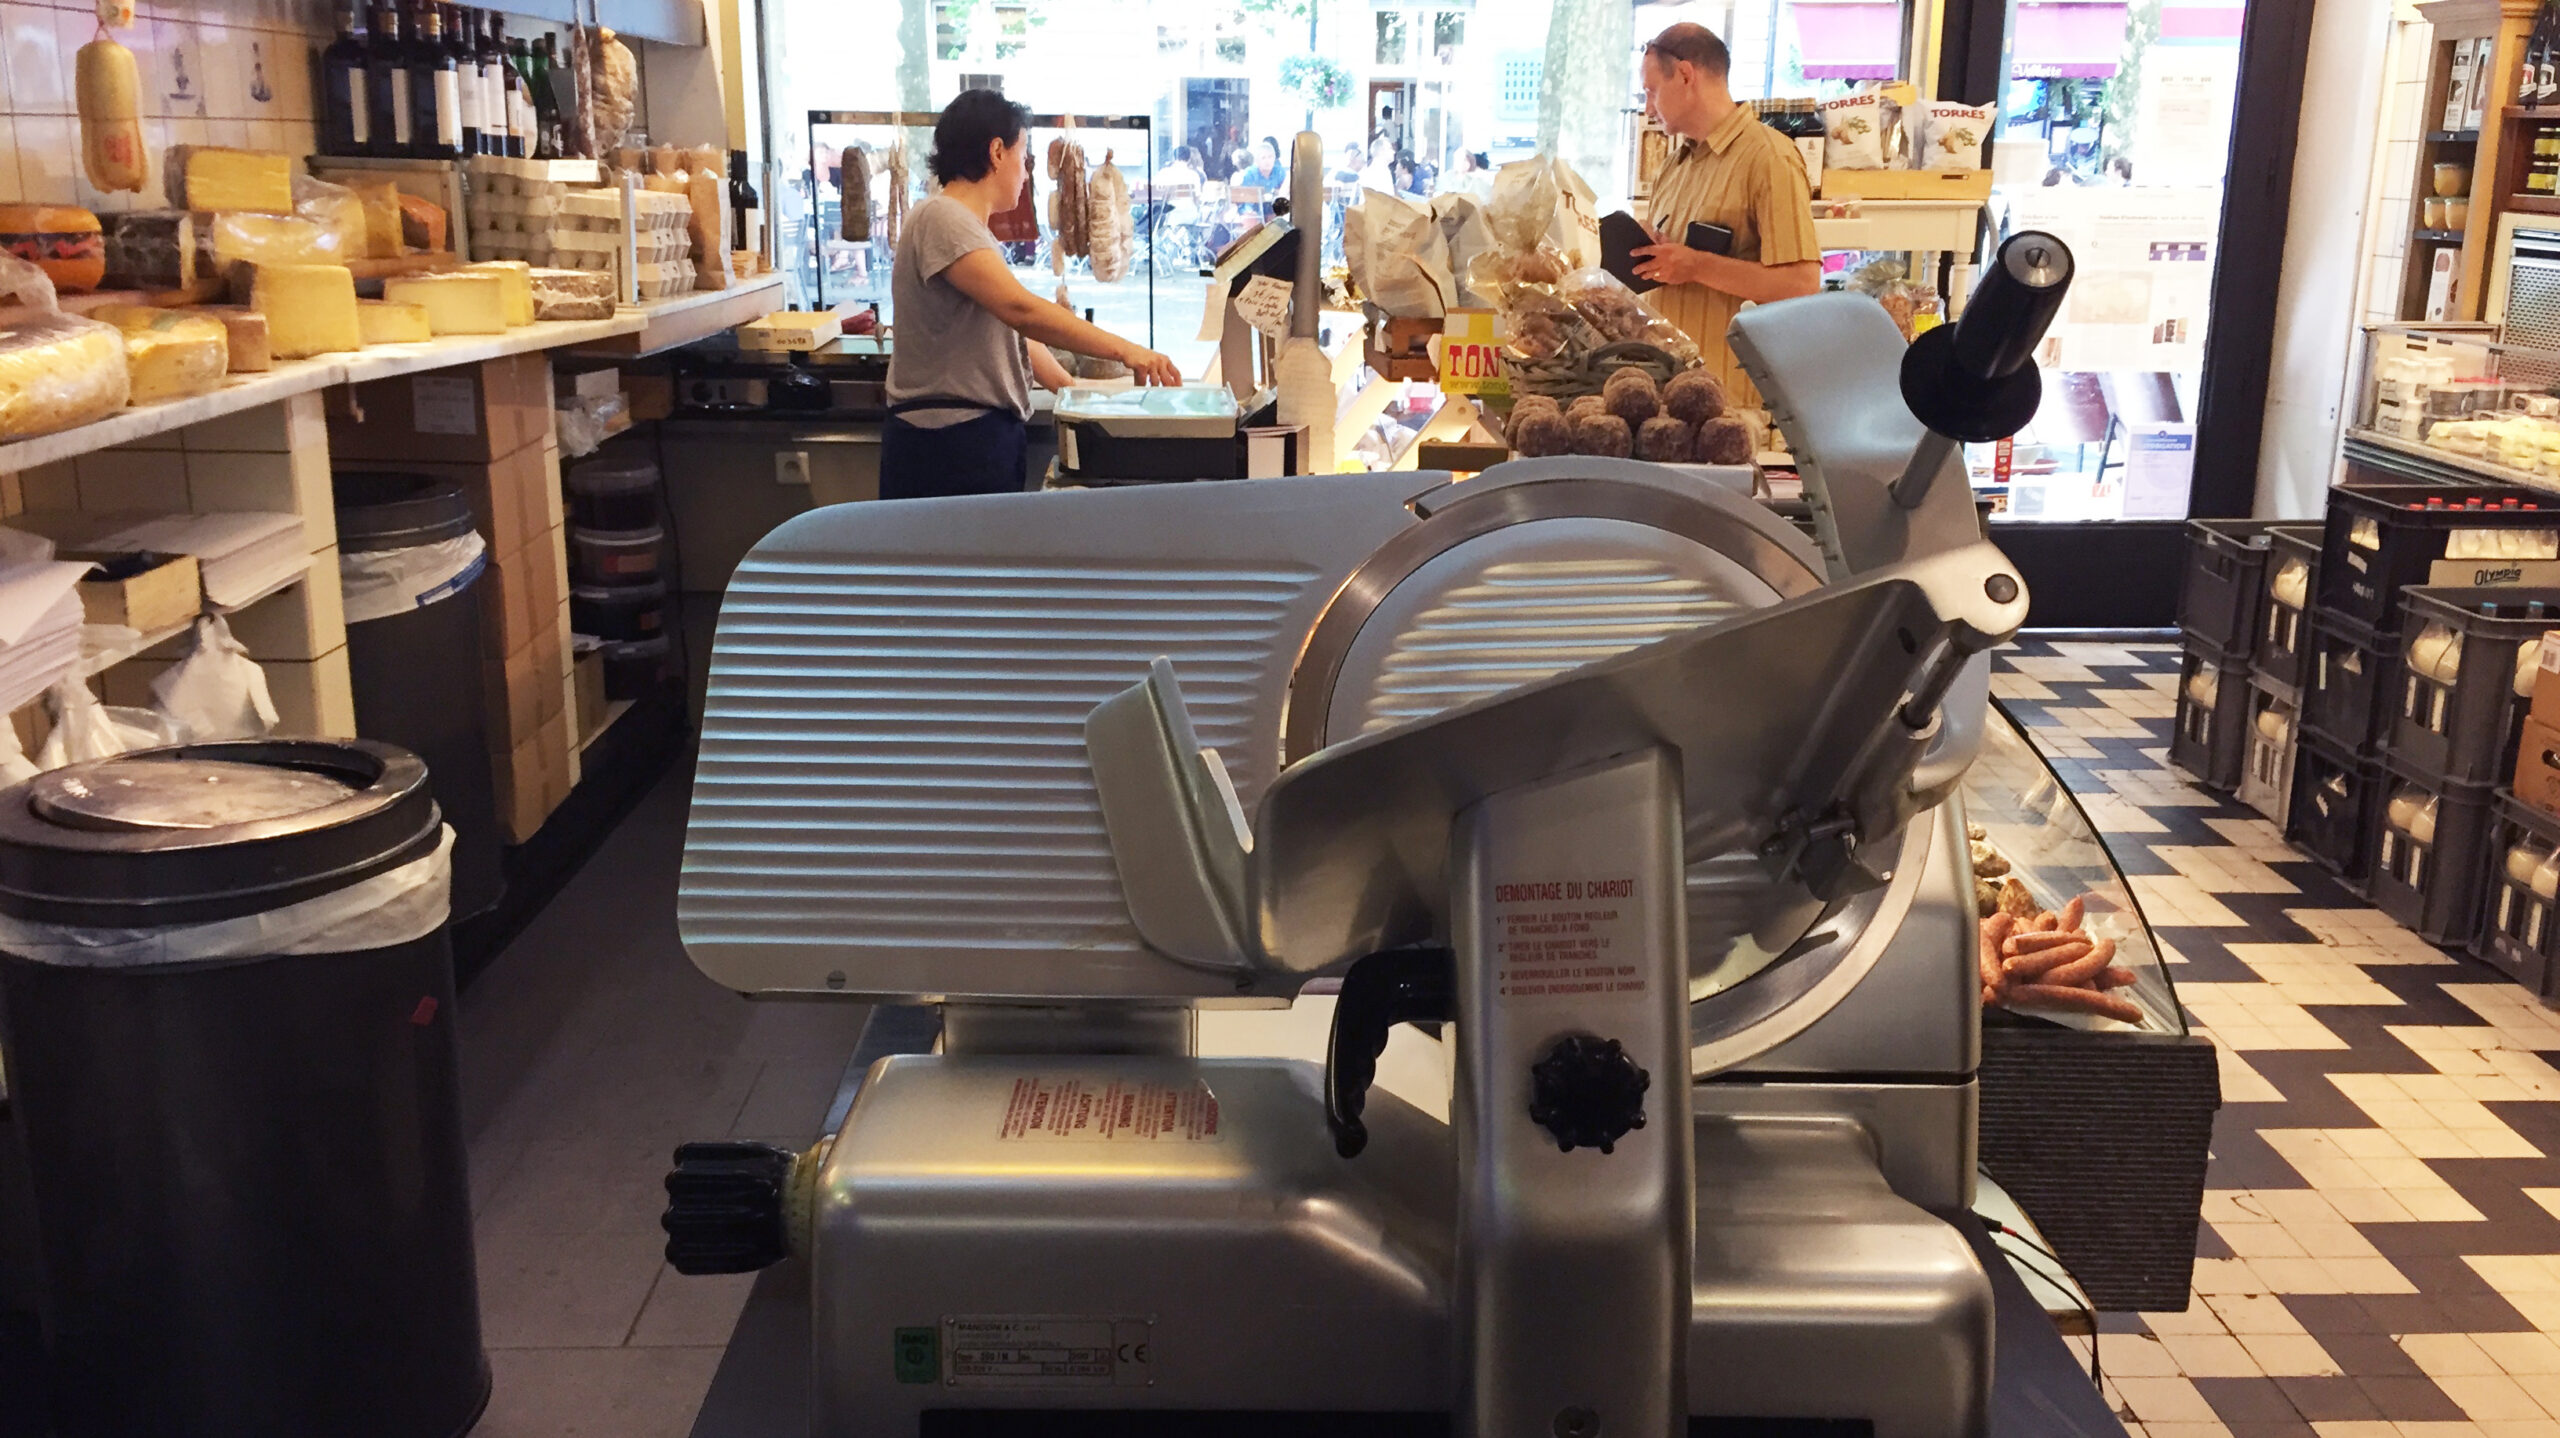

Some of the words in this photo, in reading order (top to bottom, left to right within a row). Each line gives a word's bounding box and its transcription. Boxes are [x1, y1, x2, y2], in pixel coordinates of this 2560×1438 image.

[1820, 94, 1875, 111] TORRES
[1931, 108, 1987, 120] TORRES
[1449, 344, 1502, 378] TON
[1496, 882, 1562, 902] DEMONTAGE
[1567, 882, 1582, 900] DU
[1587, 879, 1634, 899] CHARIOT
[1540, 913, 1549, 923] LE
[1551, 912, 1582, 923] BOUTON
[1601, 938, 1610, 948] LE
[1572, 968, 1582, 978] LE
[1606, 982, 1614, 992] LE
[1074, 1093, 1092, 1129] ACHTUNG
[1118, 1343, 1146, 1363] CE
